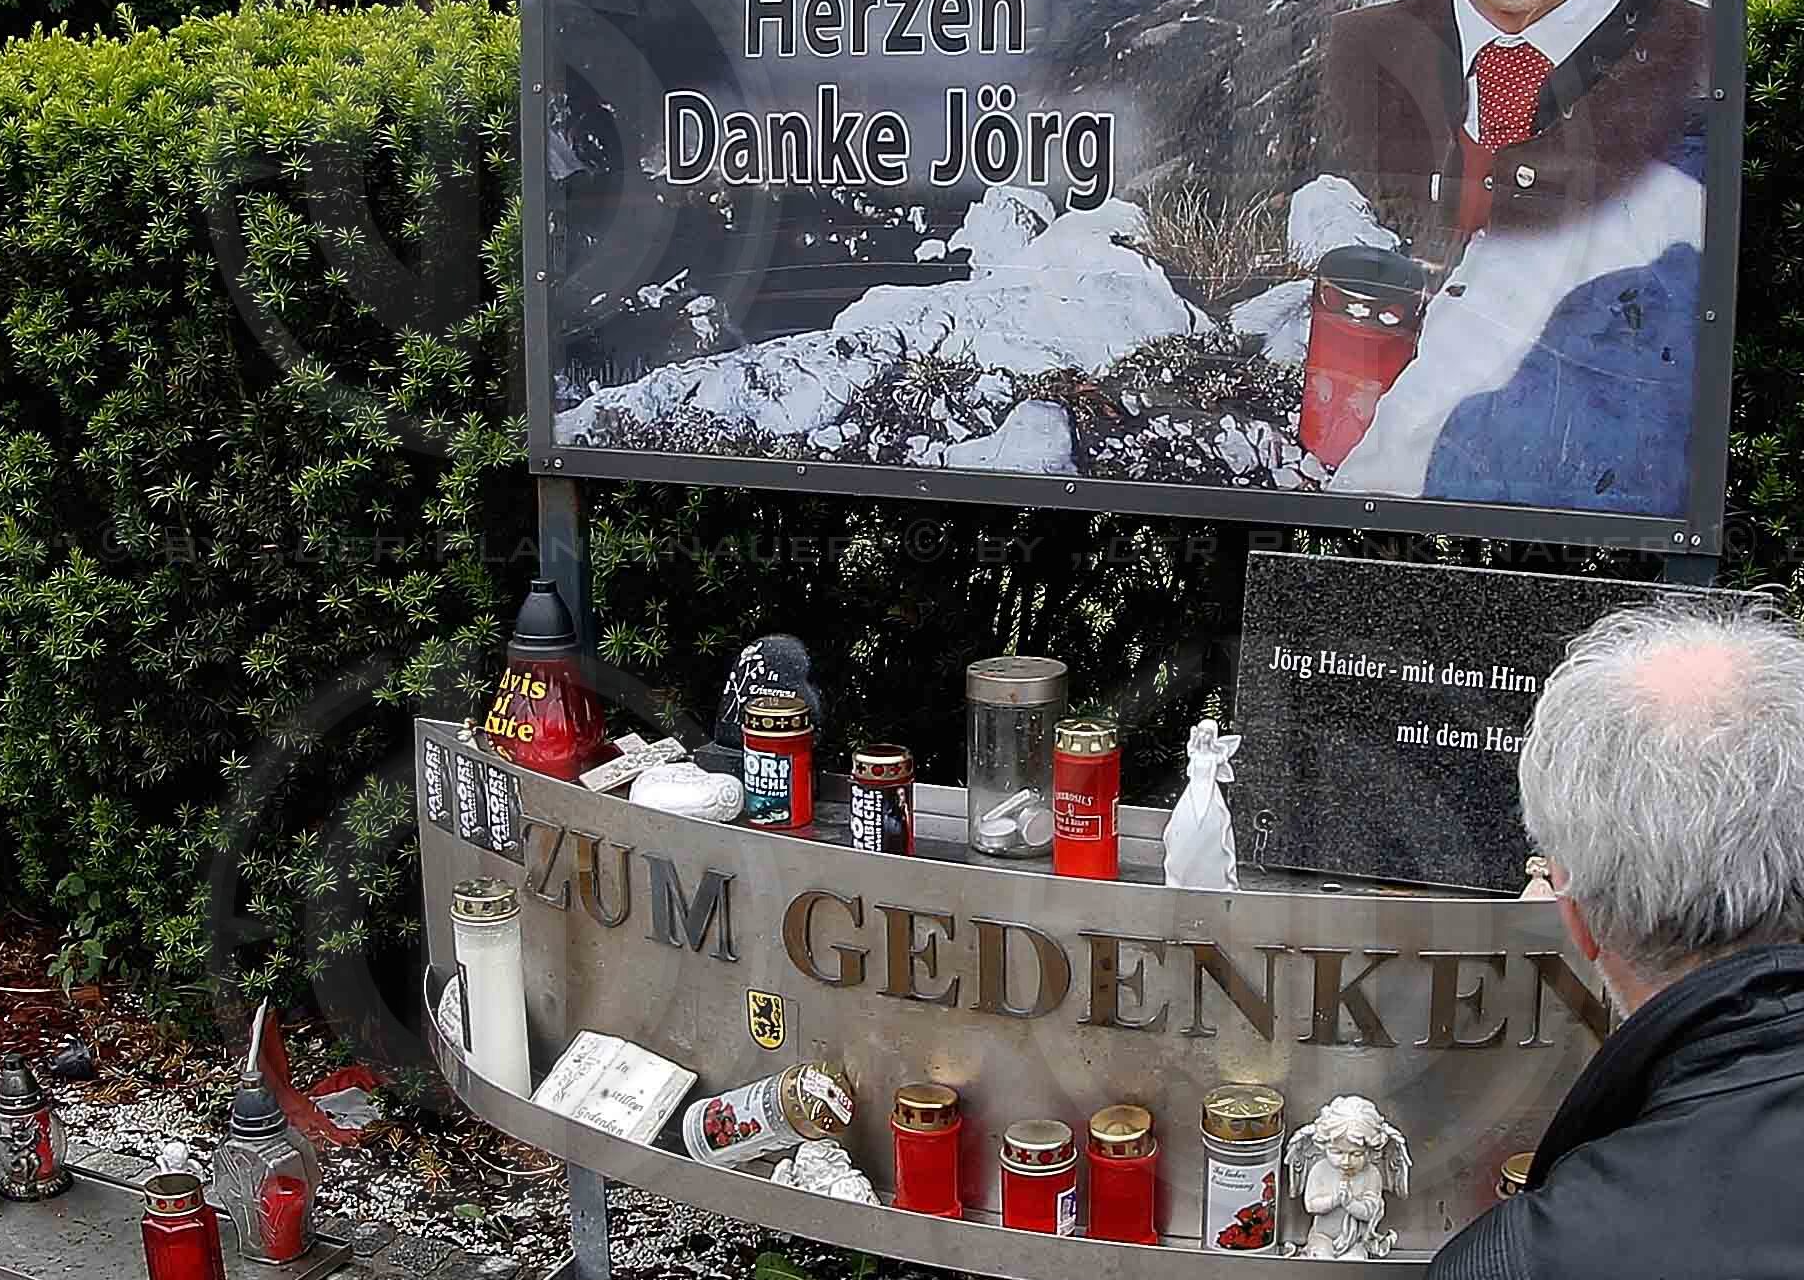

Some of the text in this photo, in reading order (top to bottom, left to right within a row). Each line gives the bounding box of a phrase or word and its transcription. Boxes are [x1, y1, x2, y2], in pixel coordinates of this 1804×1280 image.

[663, 82, 1114, 211] Danke Jörg
[768, 671, 779, 681] In
[1269, 646, 1313, 678] Jörg
[1318, 650, 1386, 679] Haider
[1402, 660, 1435, 684] mit
[1441, 662, 1484, 688] dem
[1490, 666, 1536, 693] Hirn
[1396, 720, 1429, 745] mit
[1436, 722, 1479, 749] dem
[521, 817, 1612, 1050] ZUM GEDENKEN
